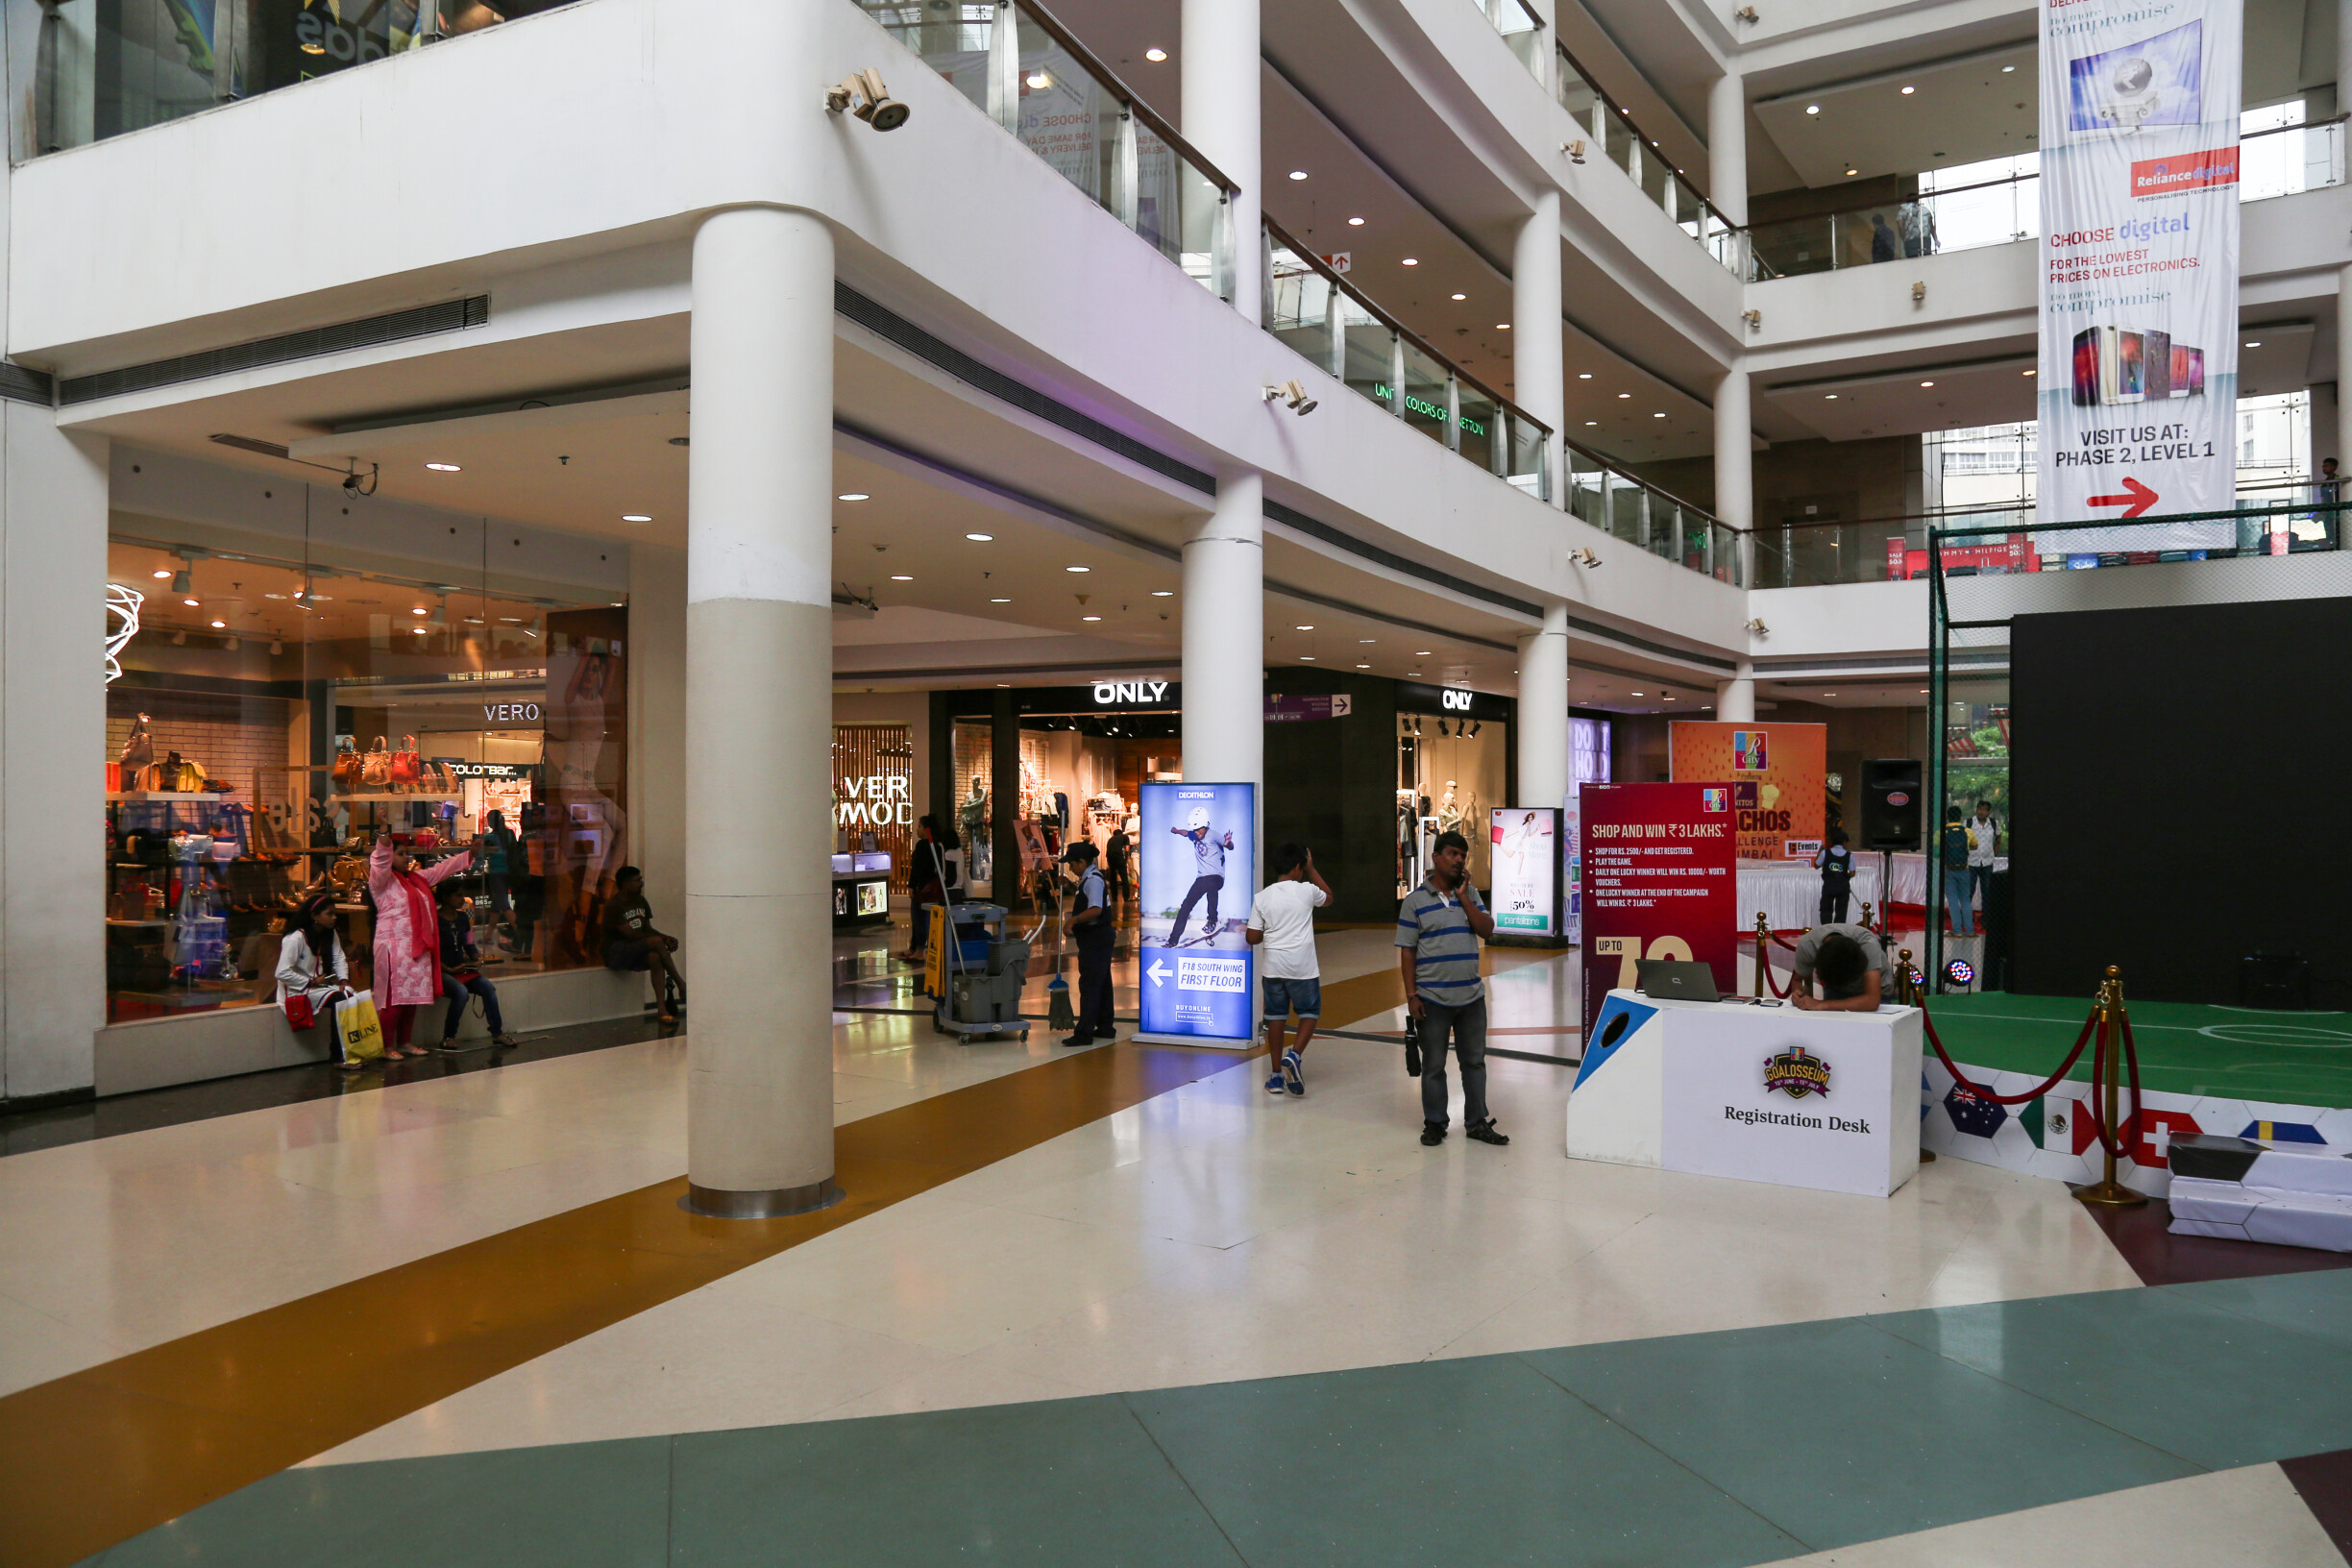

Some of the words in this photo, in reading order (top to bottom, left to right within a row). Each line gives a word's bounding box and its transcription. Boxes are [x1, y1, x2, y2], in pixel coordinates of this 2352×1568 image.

[2050, 2, 2175, 37] compromise
[2137, 191, 2189, 203] PERSONALISING
[2191, 184, 2235, 195] TECHNOLOGY
[2050, 227, 2115, 248] CHOOSE
[2119, 211, 2191, 242] digital
[2050, 258, 2072, 270] FOR
[2074, 256, 2097, 267] THE
[2099, 248, 2149, 265] LOWEST
[2050, 270, 2091, 283] PRICES
[2093, 268, 2111, 280] ON
[2114, 257, 2200, 278] ELECTRONICS.
[2050, 287, 2171, 315] compromise
[1406, 396, 1436, 418] COLORS
[1437, 407, 1448, 421] OF
[2081, 429, 2126, 447] VISIT
[2130, 426, 2156, 443] US
[2160, 424, 2189, 440] AT:
[2056, 449, 2115, 467] PHASE
[2119, 447, 2136, 464] 2,
[2141, 443, 2198, 462] LEVEL
[2203, 441, 2216, 457] 1
[1094, 682, 1168, 703] ONLY
[1443, 690, 1473, 710] ONLY
[484, 703, 539, 721] VERO
[845, 776, 908, 798] VER
[839, 802, 913, 825] MOD
[1592, 824, 1620, 838] SHOP
[1622, 824, 1643, 838] AND
[1645, 824, 1665, 838] WIN
[1512, 899, 1534, 911] 50%
[1505, 917, 1540, 926] pantaloons
[1599, 941, 1609, 951] UP
[1611, 941, 1622, 951] TO
[1183, 962, 1195, 970] F18
[1197, 963, 1221, 972] SOUTH
[1223, 965, 1243, 973] WING
[1181, 974, 1209, 986] FIRST
[1211, 975, 1241, 988] FLOOR
[1765, 1065, 1830, 1086] GOALOSSEUM
[1725, 1106, 1823, 1129] Registration
[1828, 1116, 1871, 1134] Desk
